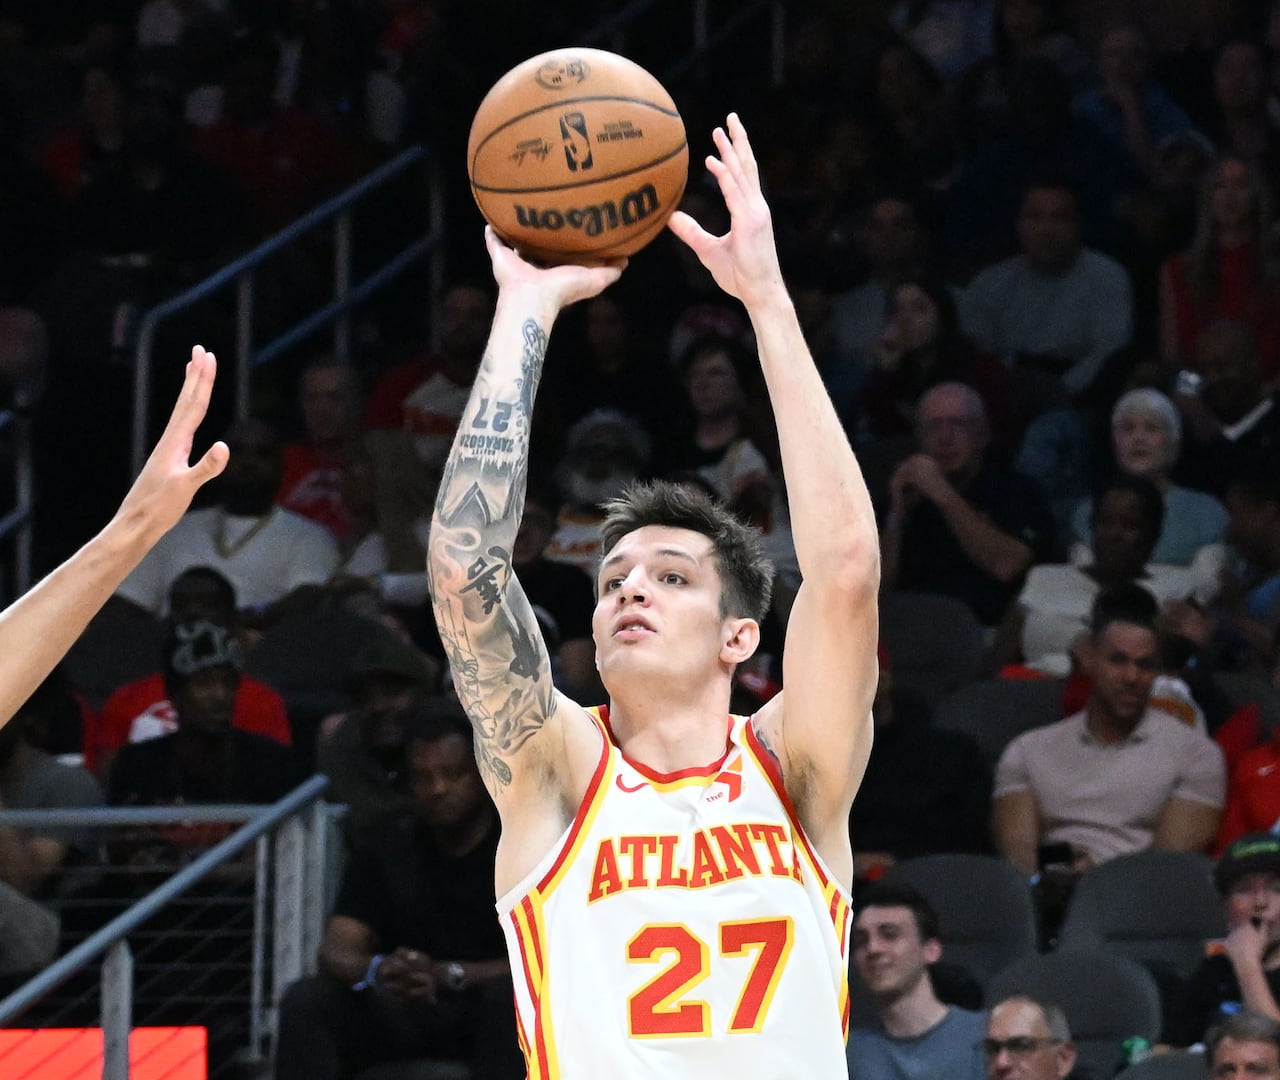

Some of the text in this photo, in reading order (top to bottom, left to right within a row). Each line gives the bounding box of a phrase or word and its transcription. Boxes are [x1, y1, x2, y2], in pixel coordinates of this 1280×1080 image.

[514, 183, 660, 237] Wilson
[472, 398, 513, 433] 27
[626, 916, 795, 1039] 27
